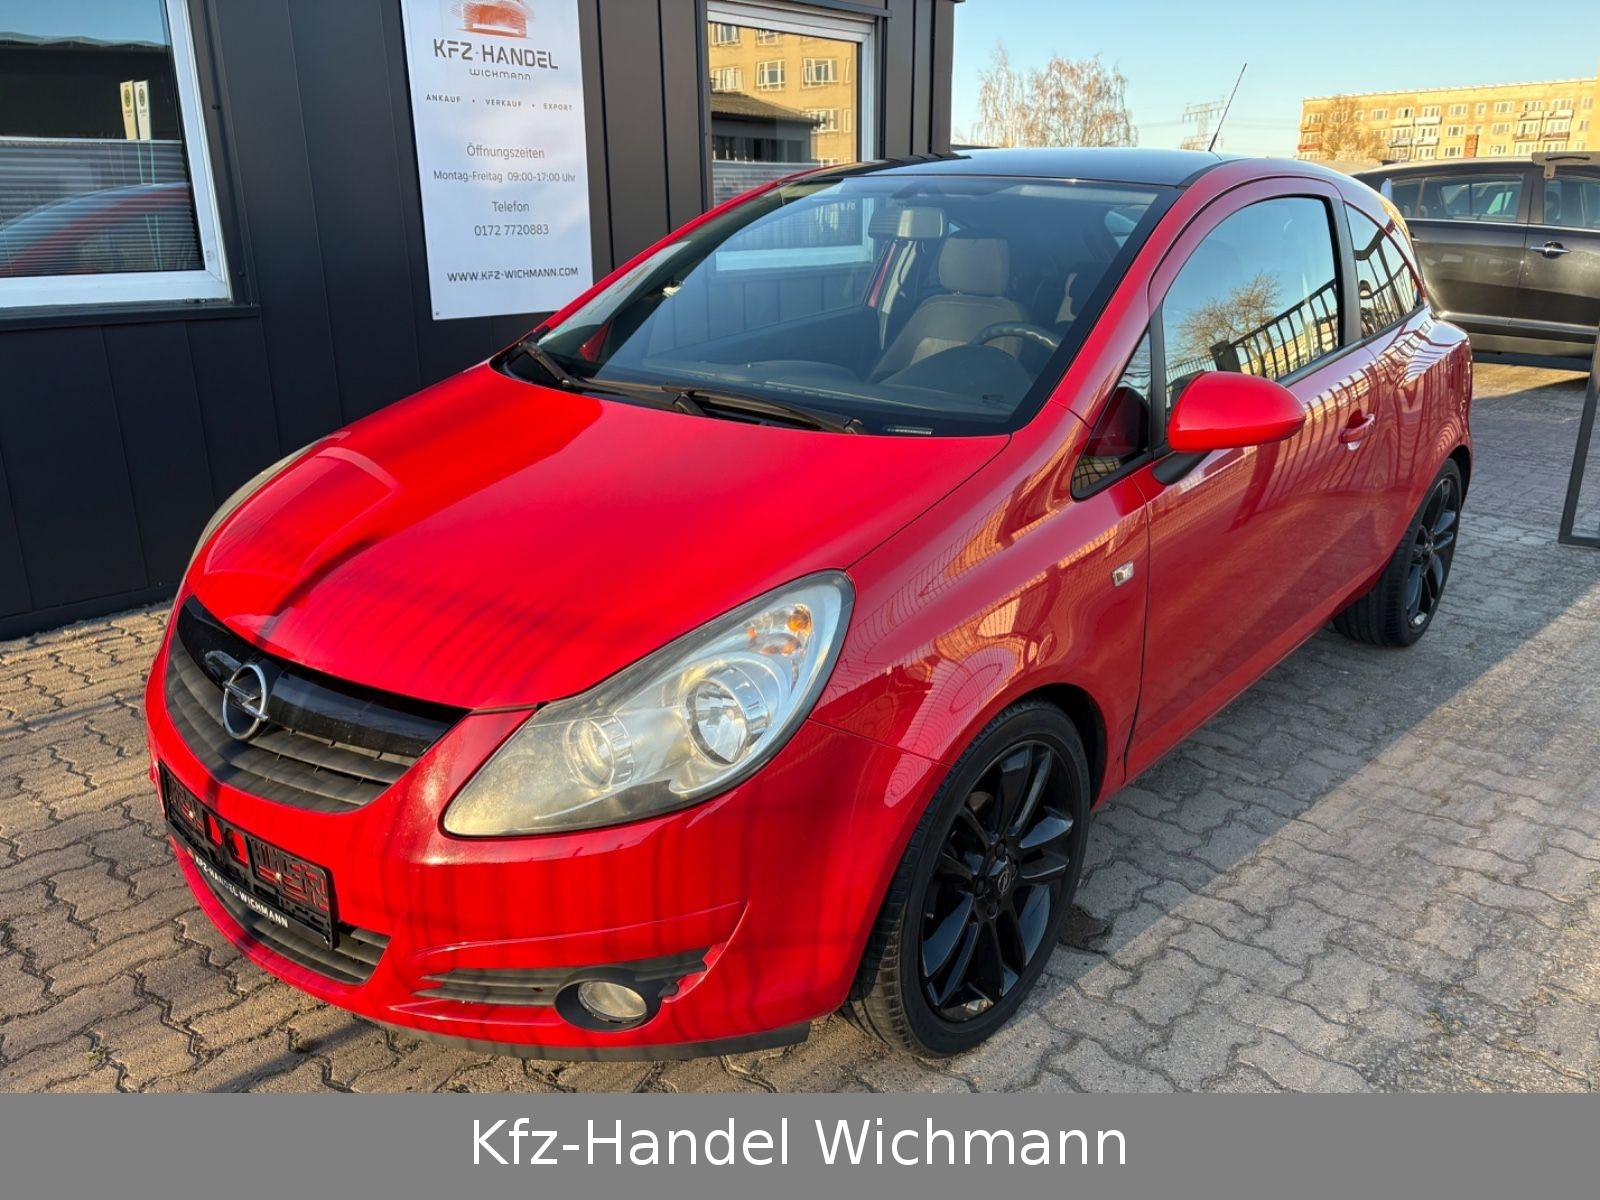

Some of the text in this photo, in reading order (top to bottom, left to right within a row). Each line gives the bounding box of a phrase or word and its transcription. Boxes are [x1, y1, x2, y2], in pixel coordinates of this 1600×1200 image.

[426, 93, 573, 112] ANKAUF VERKAUF EXPORT
[466, 143, 545, 160] Öffnungszeiten
[433, 170, 576, 183] Montag-Freitag 09:00-17:00 Uhr
[492, 201, 530, 213] Telefon
[474, 224, 549, 236] 0172 7720883
[447, 267, 579, 282] WWW.KFZ-WICHMANN.COM
[239, 891, 288, 928] WICHMANN
